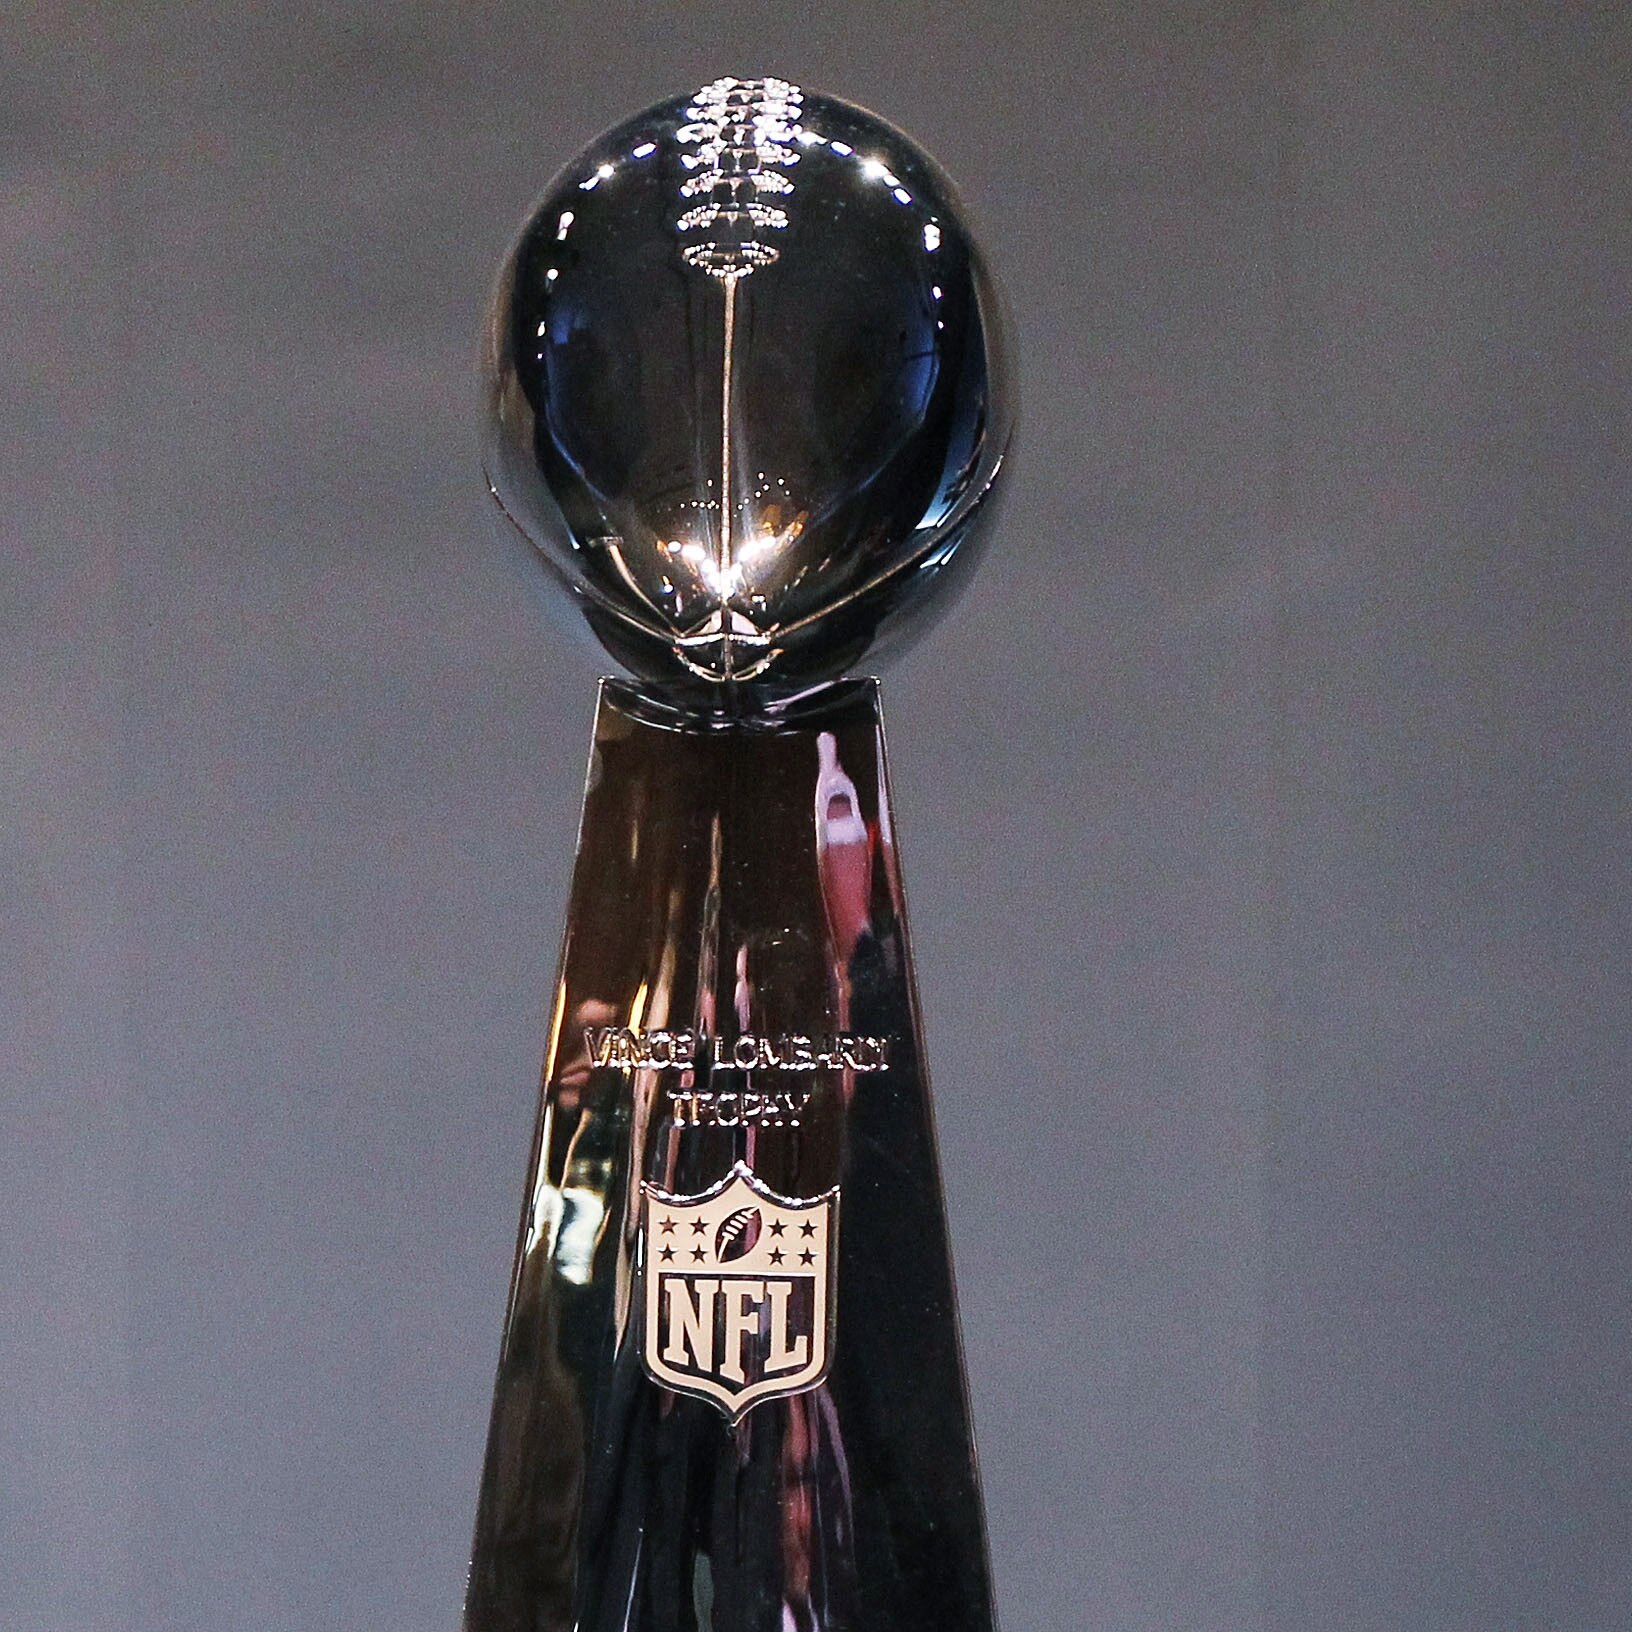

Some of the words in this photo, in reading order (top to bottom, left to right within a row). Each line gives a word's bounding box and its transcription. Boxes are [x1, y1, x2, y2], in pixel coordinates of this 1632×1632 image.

[583, 1026, 694, 1068] VINCE
[667, 1091, 810, 1127] TROPHY
[664, 1278, 808, 1383] NFL
